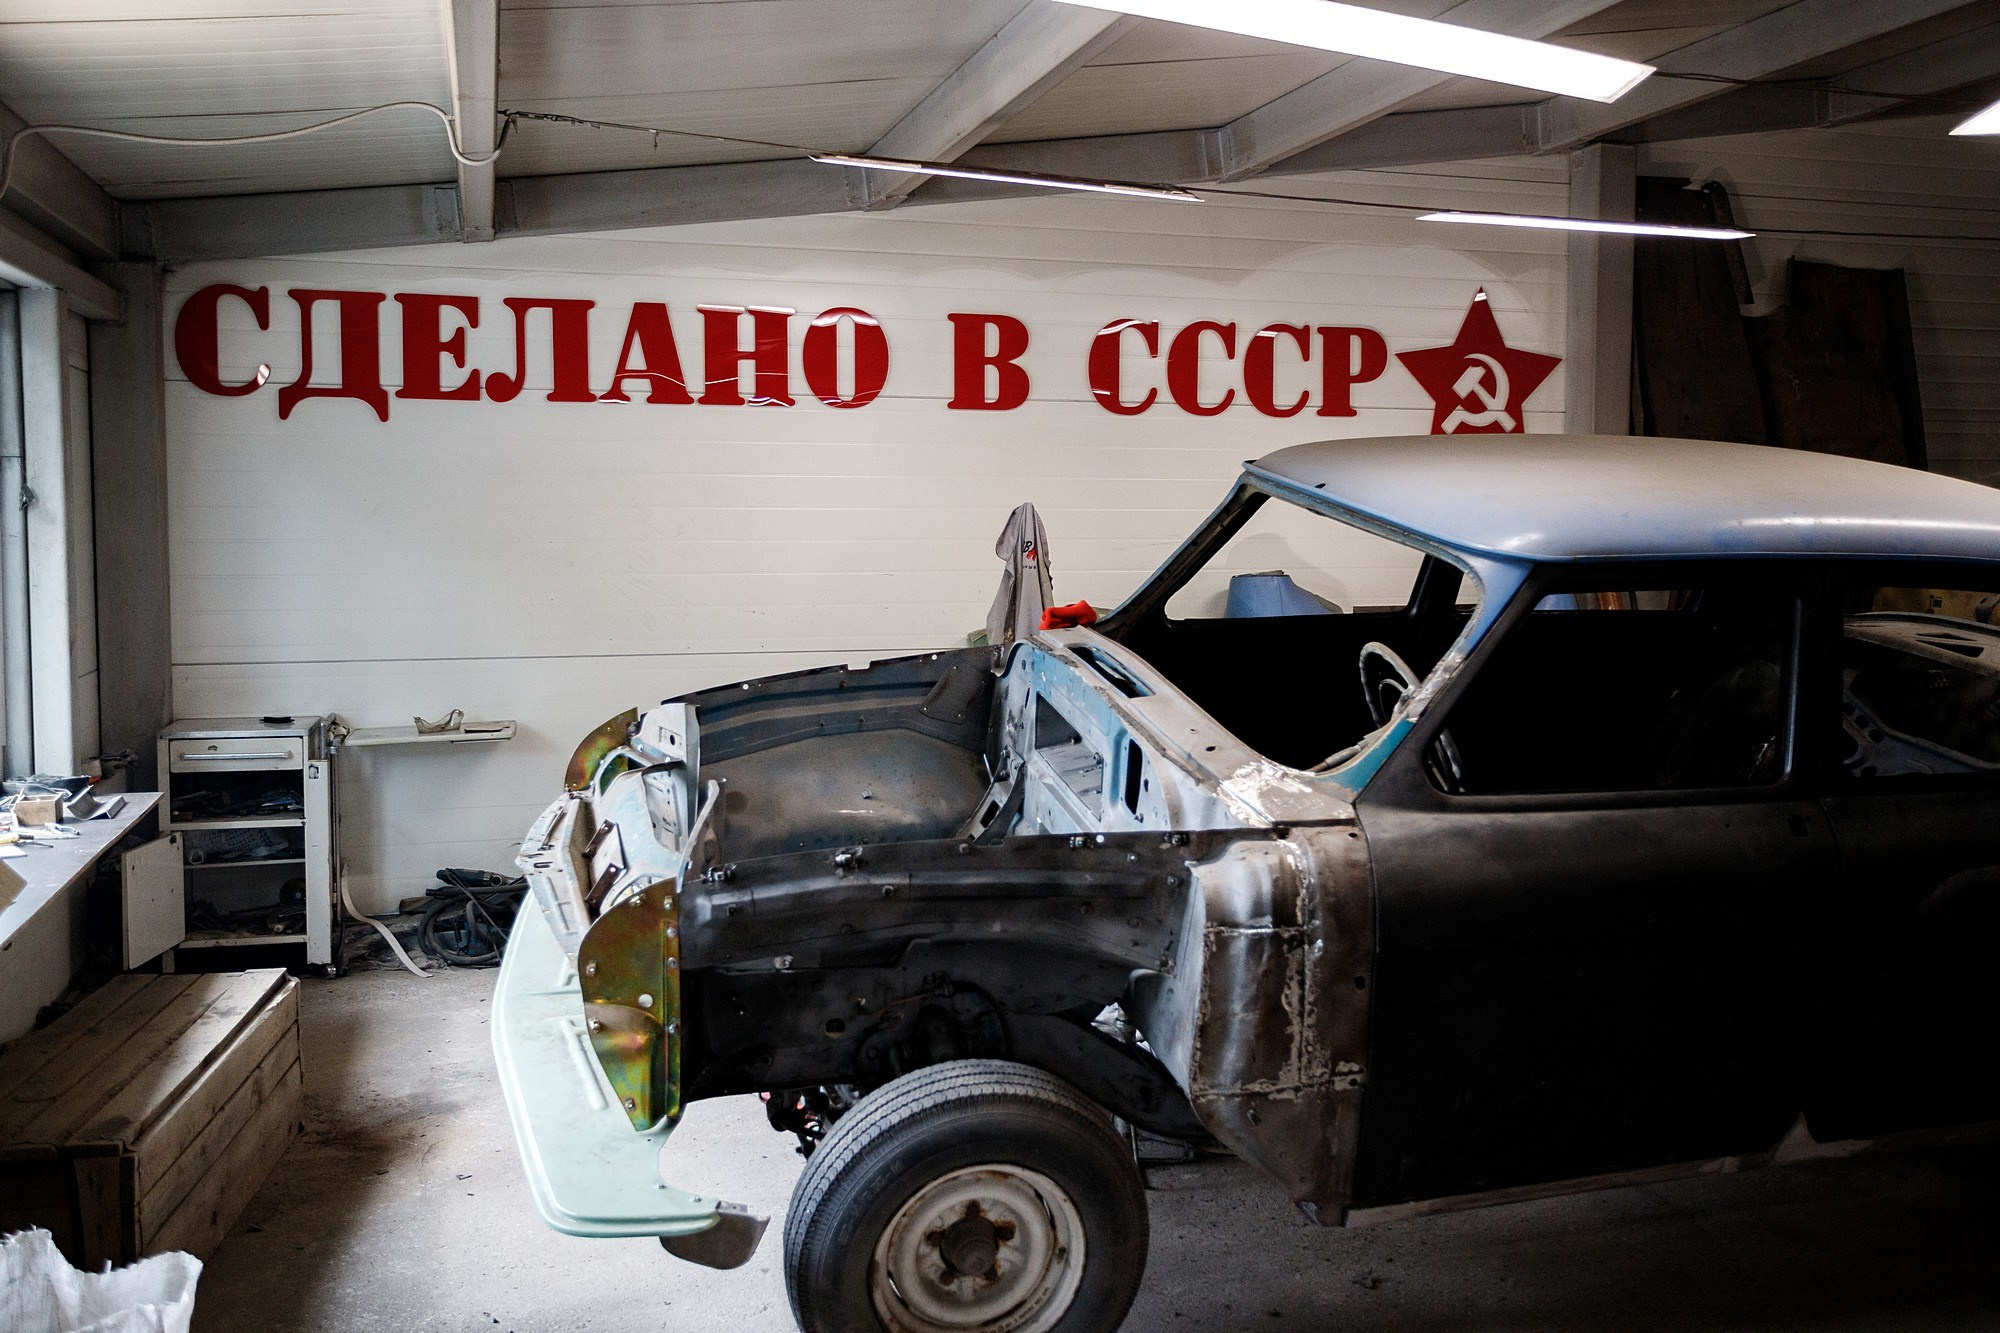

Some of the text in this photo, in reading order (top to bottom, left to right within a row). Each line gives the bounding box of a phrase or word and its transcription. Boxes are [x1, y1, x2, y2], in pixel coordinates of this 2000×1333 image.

[174, 283, 1389, 423] СДЕЛАНО В СССР
